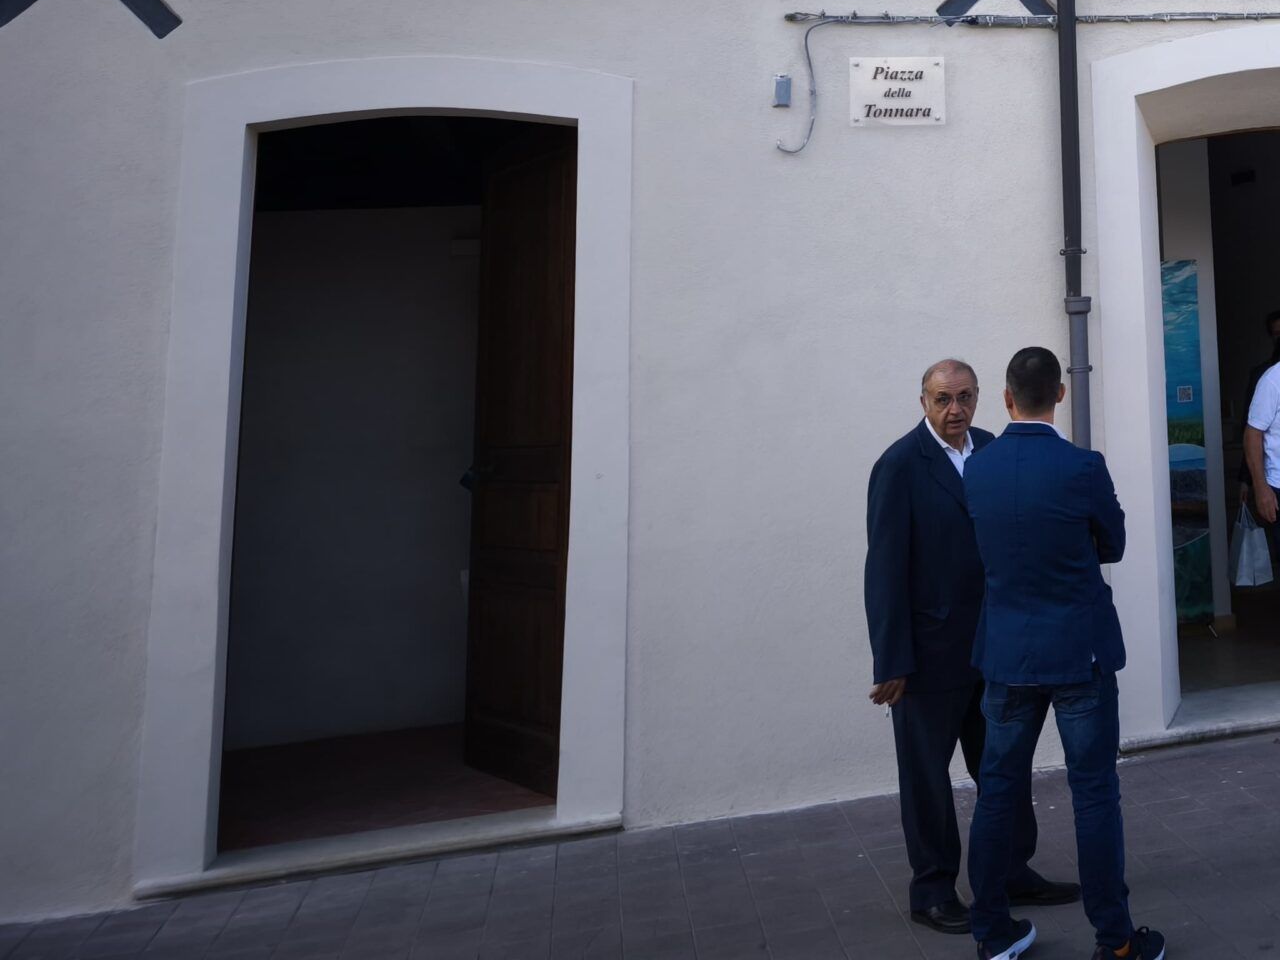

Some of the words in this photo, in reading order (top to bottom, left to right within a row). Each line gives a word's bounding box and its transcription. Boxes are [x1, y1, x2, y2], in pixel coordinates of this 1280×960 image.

[872, 66, 925, 81] Piazza
[884, 87, 912, 98] della
[864, 104, 932, 119] Tonnara
